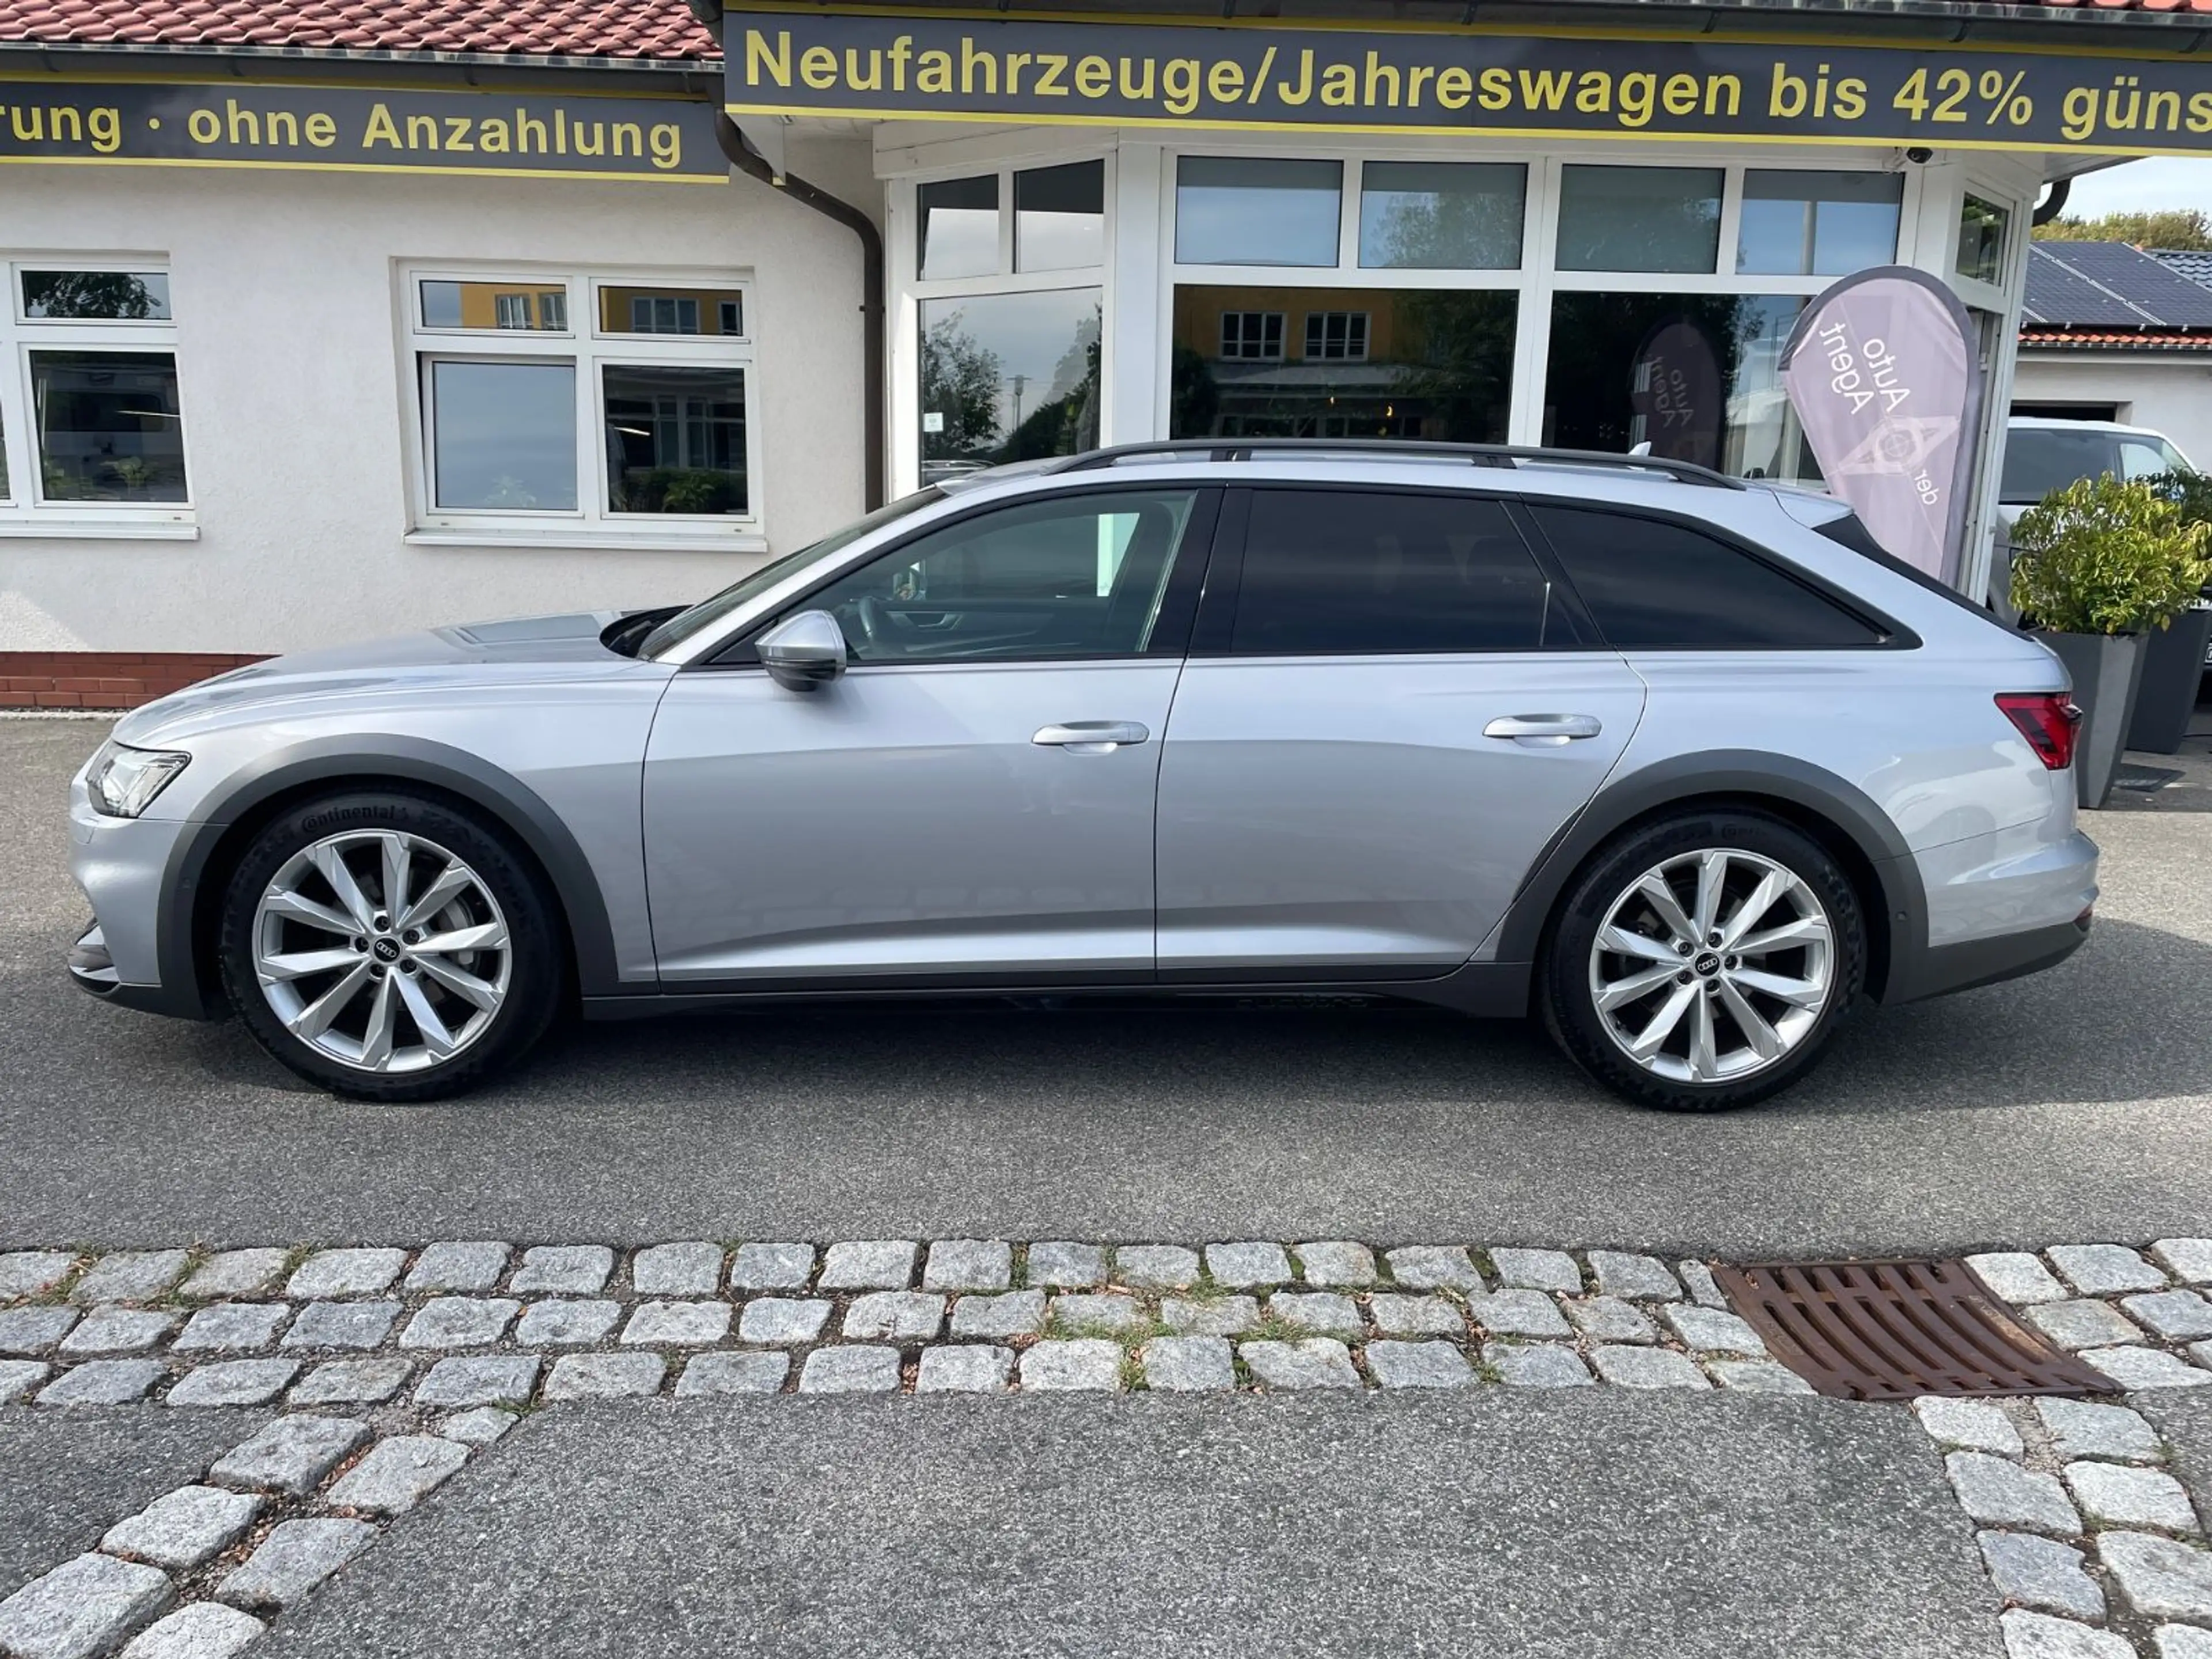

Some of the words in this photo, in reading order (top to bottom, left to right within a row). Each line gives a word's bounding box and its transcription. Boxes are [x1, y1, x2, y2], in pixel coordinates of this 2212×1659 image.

[745, 30, 1741, 127] Neufahrzeuge/Jahreswagen
[1768, 63, 1867, 119] bis
[1893, 68, 2033, 126] 42%
[2062, 76, 2212, 141] güns
[0, 105, 121, 153] ung
[188, 100, 336, 148] ohne
[362, 103, 682, 169] Anzahlung
[301, 805, 396, 833] Continental
